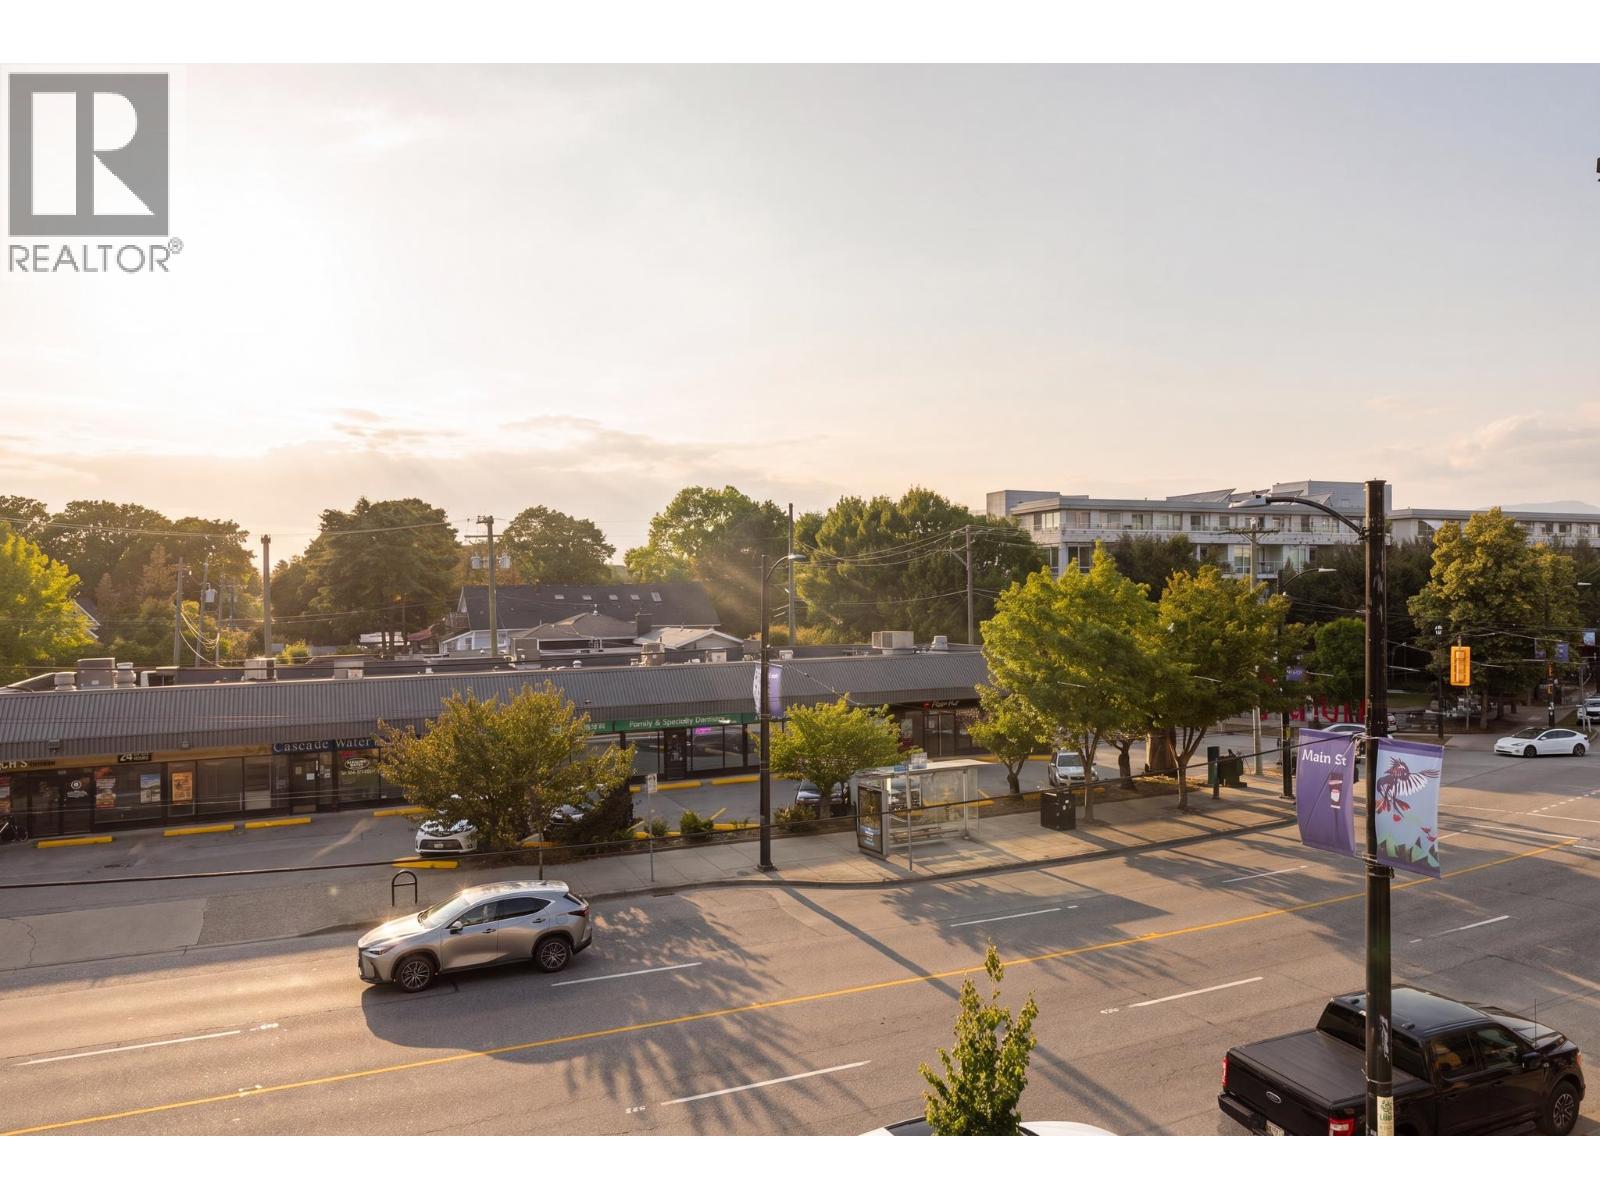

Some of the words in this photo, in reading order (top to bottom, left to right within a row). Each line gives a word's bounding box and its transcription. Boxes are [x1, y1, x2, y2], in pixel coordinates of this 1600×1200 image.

[629, 720, 653, 729] Family
[654, 719, 661, 727] &
[273, 741, 329, 753] Cascade
[335, 738, 370, 748] Water
[120, 752, 133, 761] 24
[1302, 749, 1331, 764] Main
[1334, 753, 1347, 766] St
[0, 760, 28, 770] CH'S
